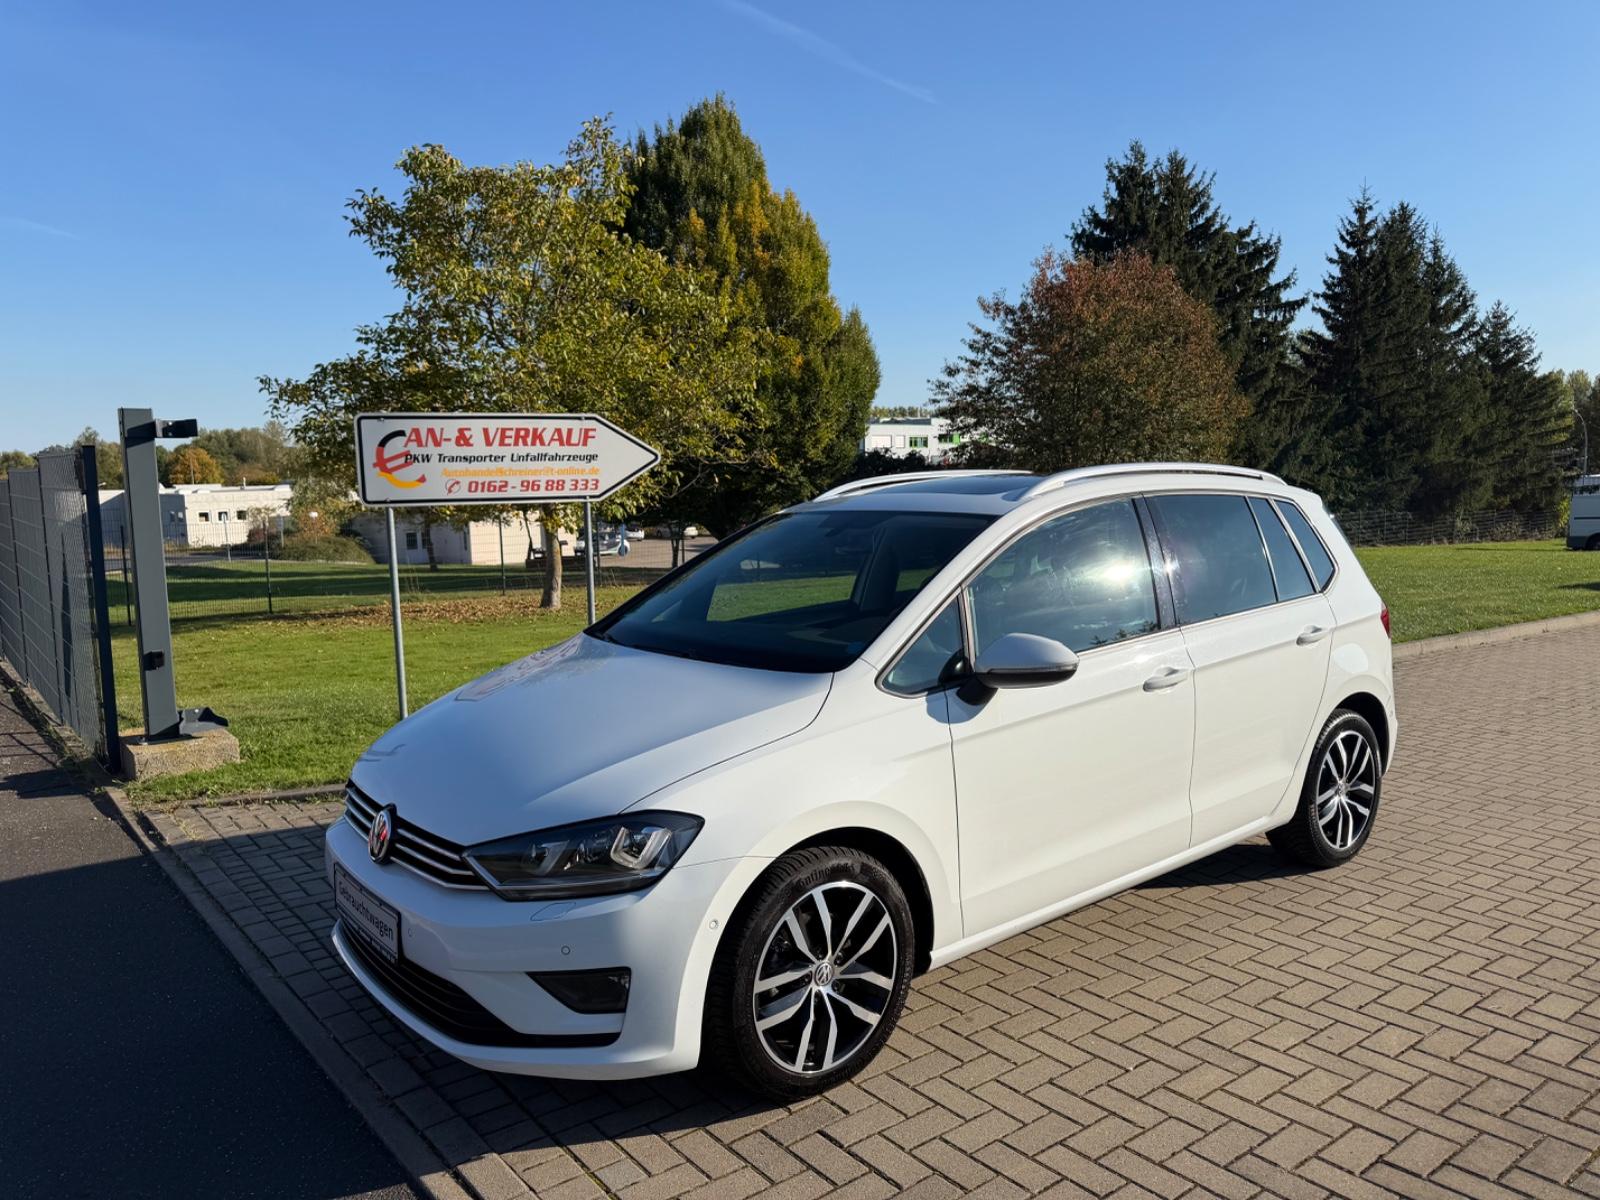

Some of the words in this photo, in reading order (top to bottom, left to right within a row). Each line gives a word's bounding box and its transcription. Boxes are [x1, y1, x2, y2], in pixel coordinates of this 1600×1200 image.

[482, 427, 597, 448] VERKAUF
[404, 453, 432, 464] PKW
[438, 453, 506, 465] Transporter
[510, 452, 599, 464] Unfallfahrzeuge
[467, 480, 509, 493] 0162
